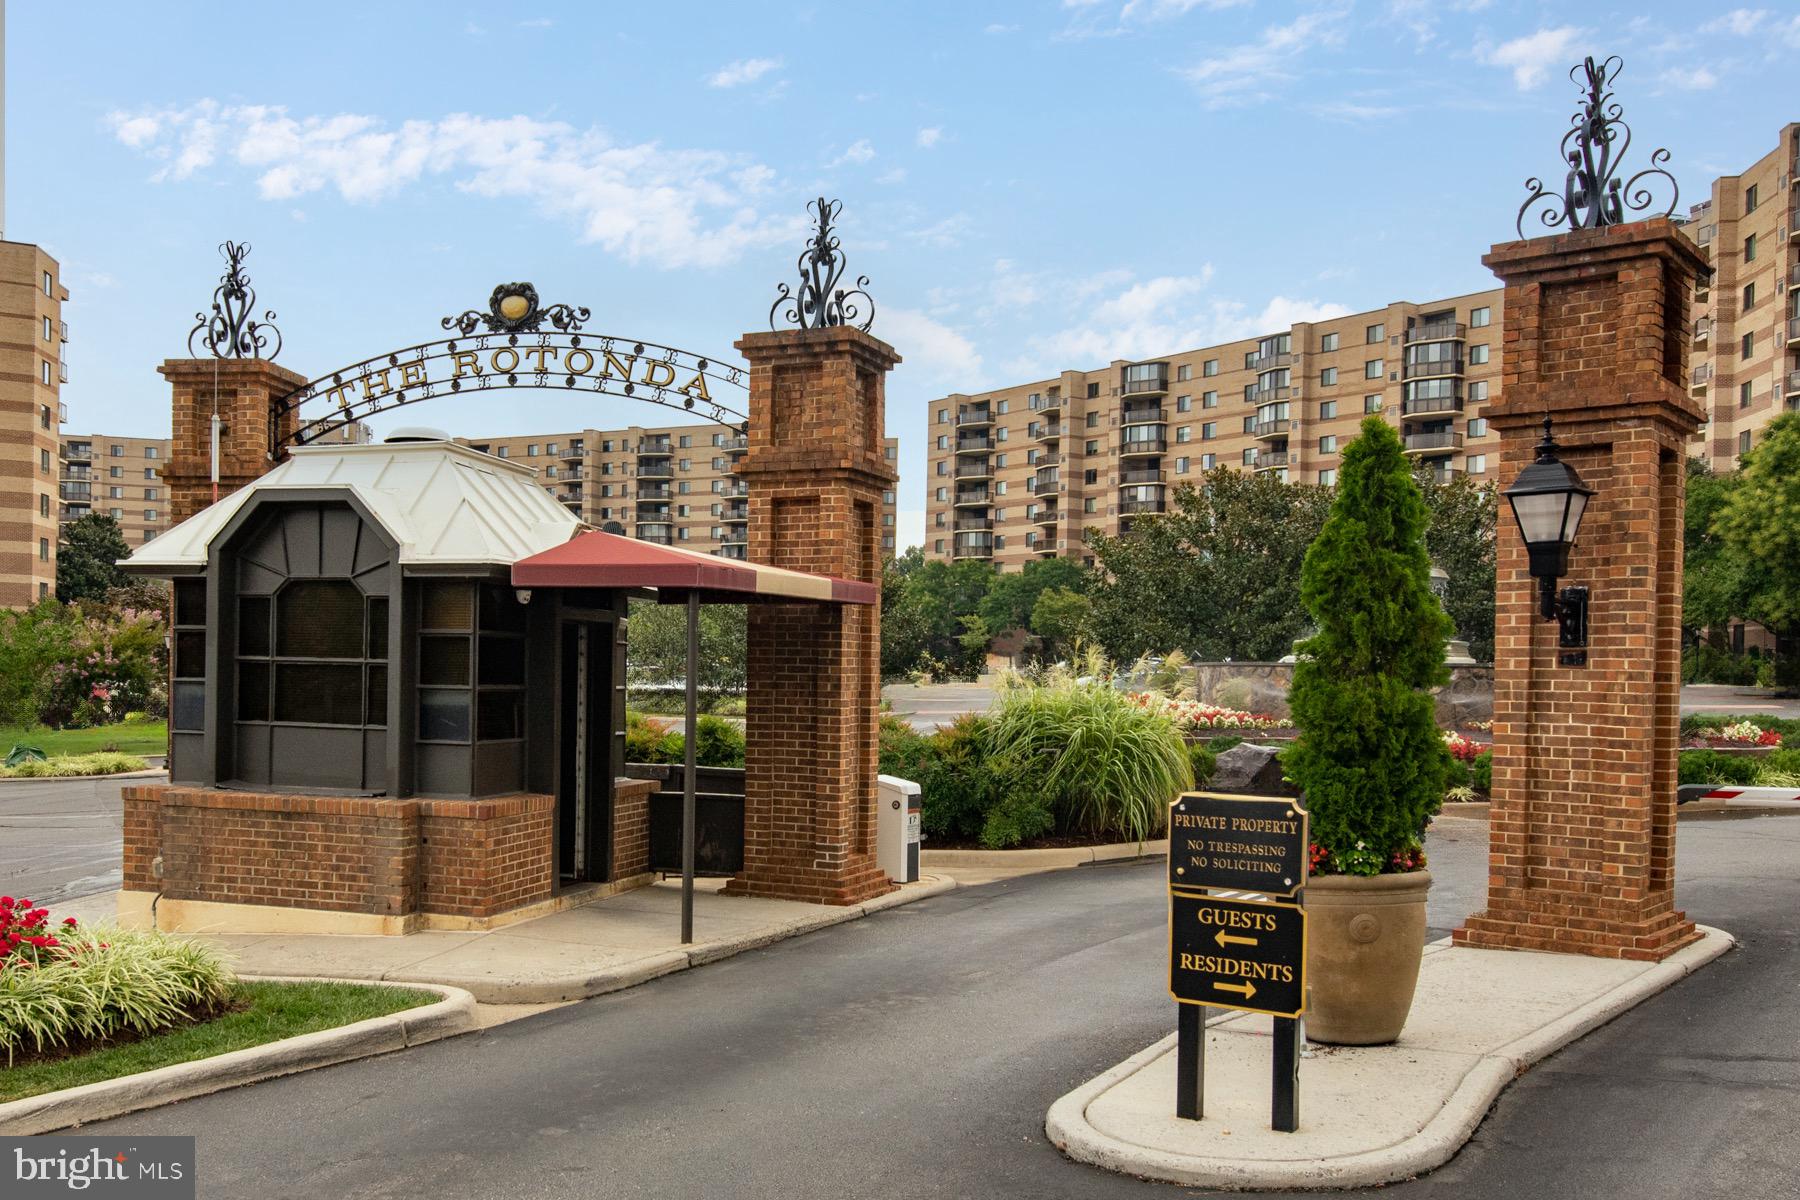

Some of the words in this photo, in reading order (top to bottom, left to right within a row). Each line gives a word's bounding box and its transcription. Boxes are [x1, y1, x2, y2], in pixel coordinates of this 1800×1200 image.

[326, 360, 429, 410] THE
[451, 347, 713, 401] ROTONDA
[1174, 814, 1227, 830] PRIVATE
[1232, 817, 1298, 834] PROPERTY
[1187, 839, 1204, 851] NO
[1208, 841, 1286, 857] TRESPASSING
[1191, 856, 1208, 868] NO
[1212, 857, 1281, 873] SOLICITING
[1198, 908, 1276, 931] GUESTS
[1180, 953, 1293, 982] RESIDENTS
